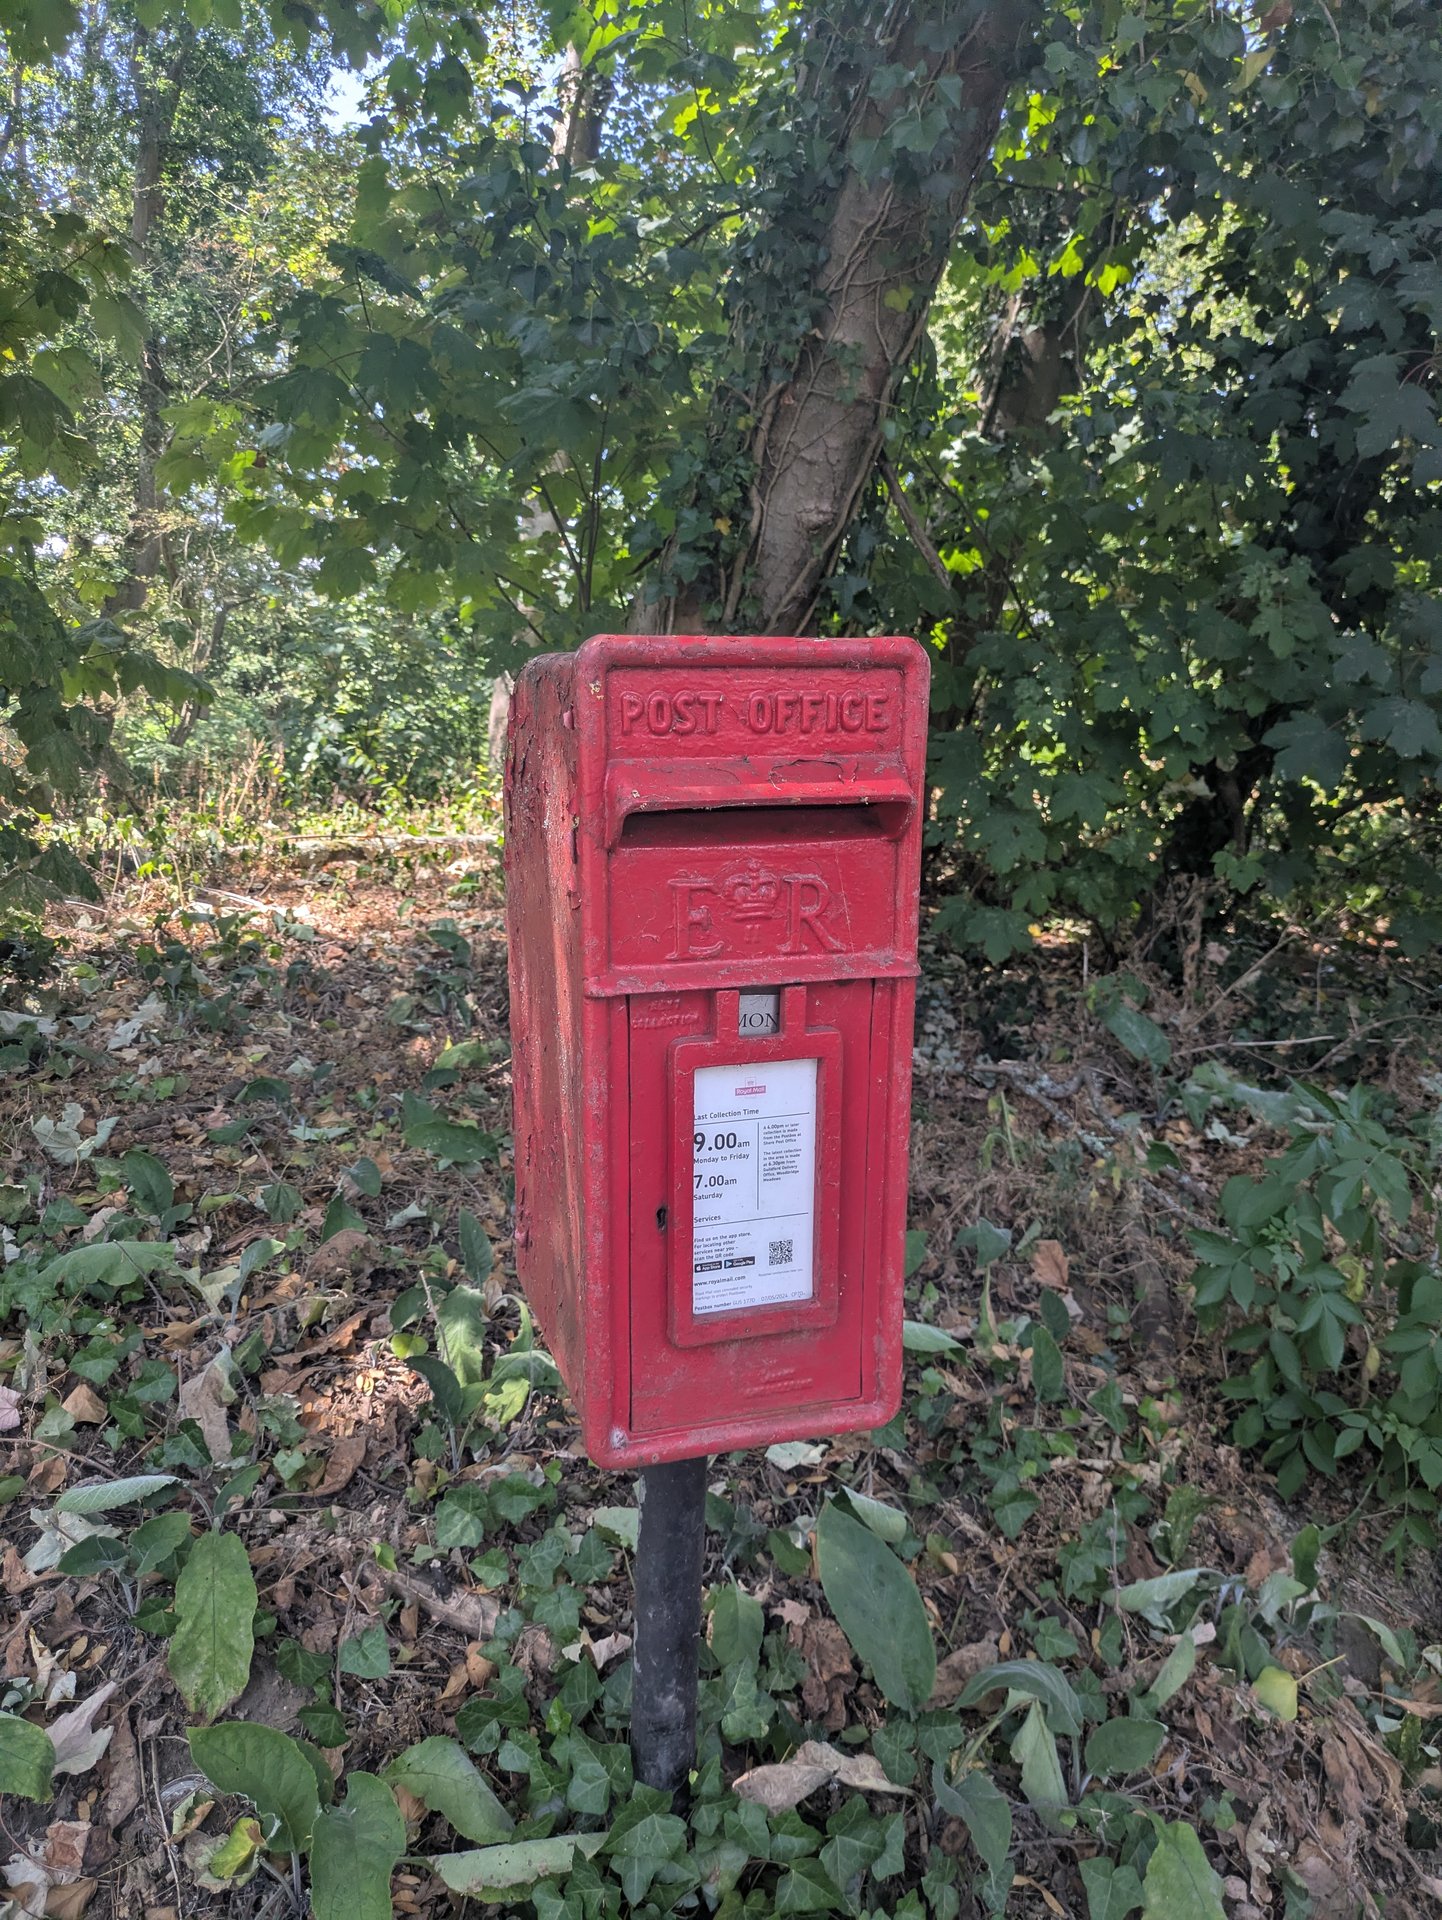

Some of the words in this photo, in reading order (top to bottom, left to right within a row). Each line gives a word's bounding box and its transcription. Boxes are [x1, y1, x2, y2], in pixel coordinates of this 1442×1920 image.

[619, 690, 723, 737] POST
[748, 688, 891, 734] OFFICE
[665, 877, 724, 962] E
[776, 872, 848, 955] R
[736, 1087, 751, 1095] Royal
[710, 1111, 741, 1119] Collection
[694, 1132, 750, 1152] 9.00am
[694, 1175, 737, 1189] 7.00am
[694, 1192, 723, 1200] Saturday
[694, 1215, 721, 1223] Services
[694, 1276, 746, 1286] www.royalmail.com
